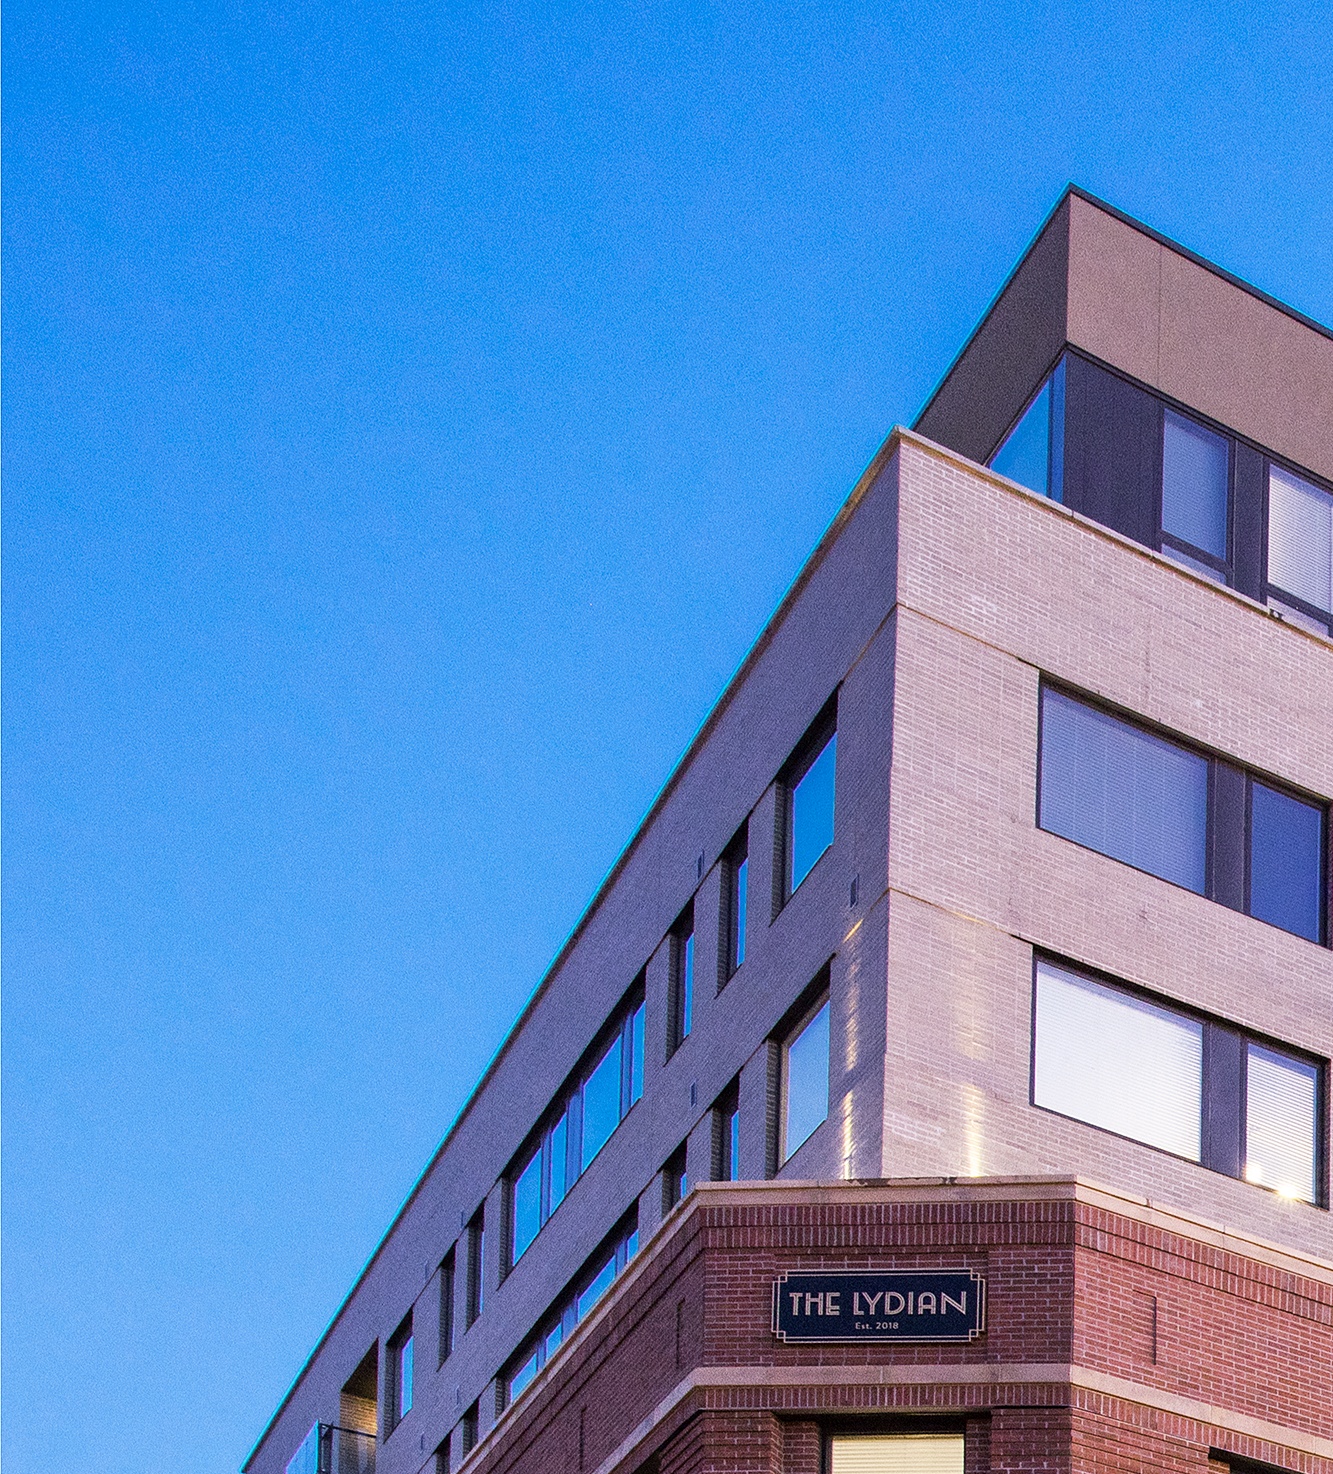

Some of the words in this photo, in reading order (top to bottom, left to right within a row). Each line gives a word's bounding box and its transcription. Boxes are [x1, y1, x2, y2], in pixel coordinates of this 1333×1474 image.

[789, 1292, 841, 1316] THE
[853, 1291, 967, 1316] LYDIAN
[855, 1322, 872, 1330] Est.
[876, 1321, 899, 1330] 2018
